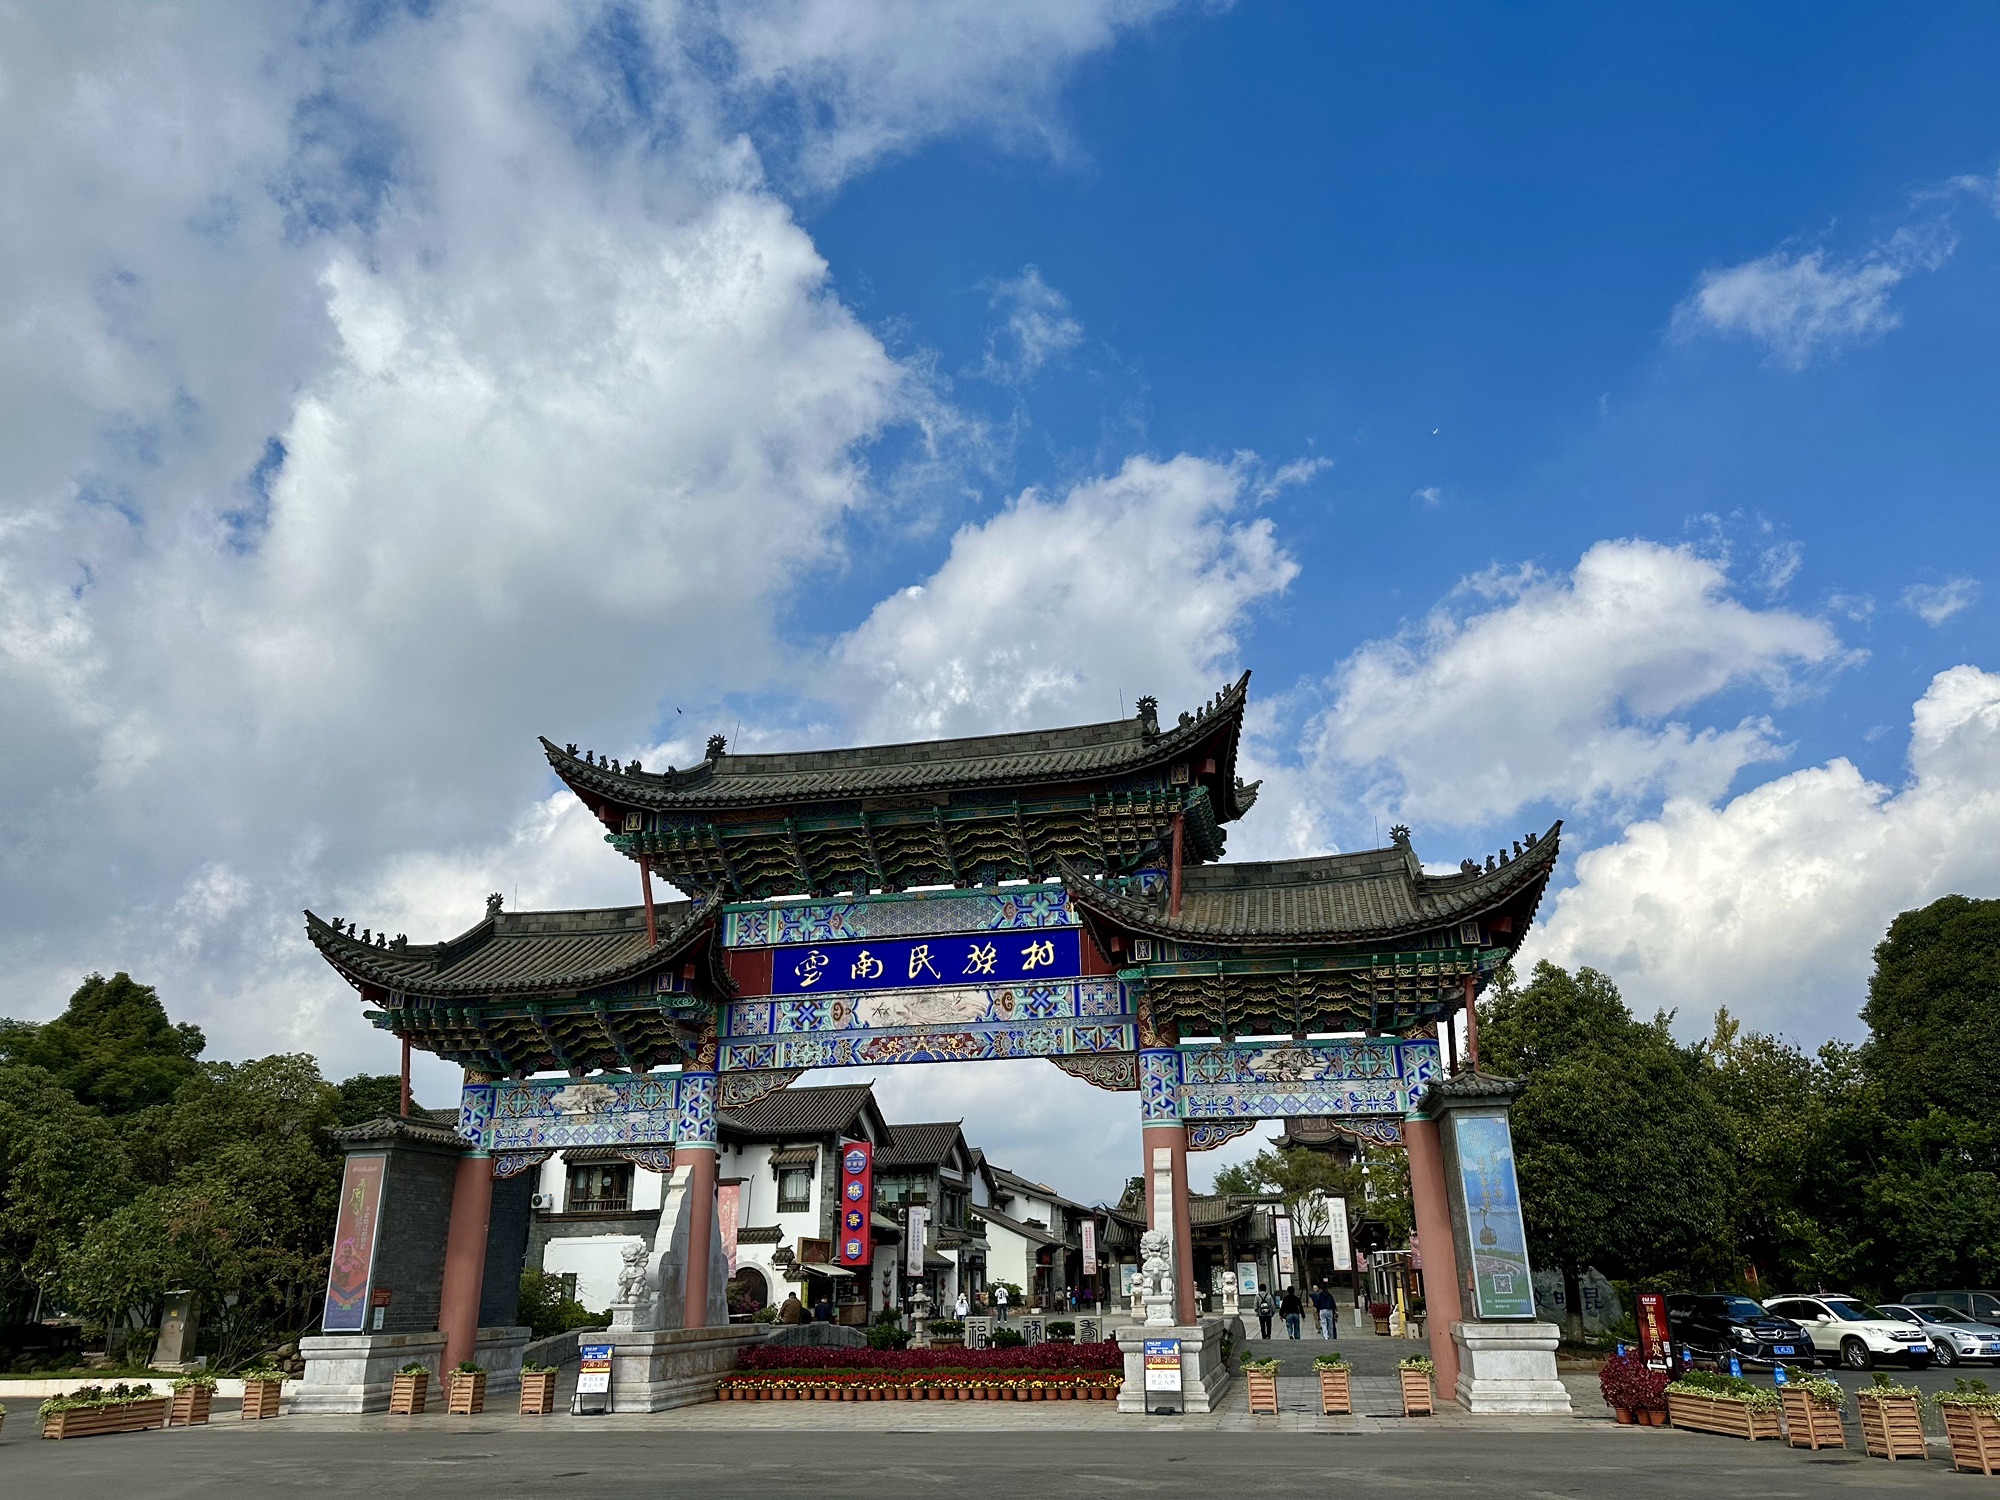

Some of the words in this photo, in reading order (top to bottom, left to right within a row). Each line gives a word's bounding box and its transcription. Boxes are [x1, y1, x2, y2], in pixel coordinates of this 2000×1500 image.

[847, 1184, 861, 1255] 桥香园
[969, 1321, 986, 1349] 福
[1647, 1313, 1662, 1357] 售票处
